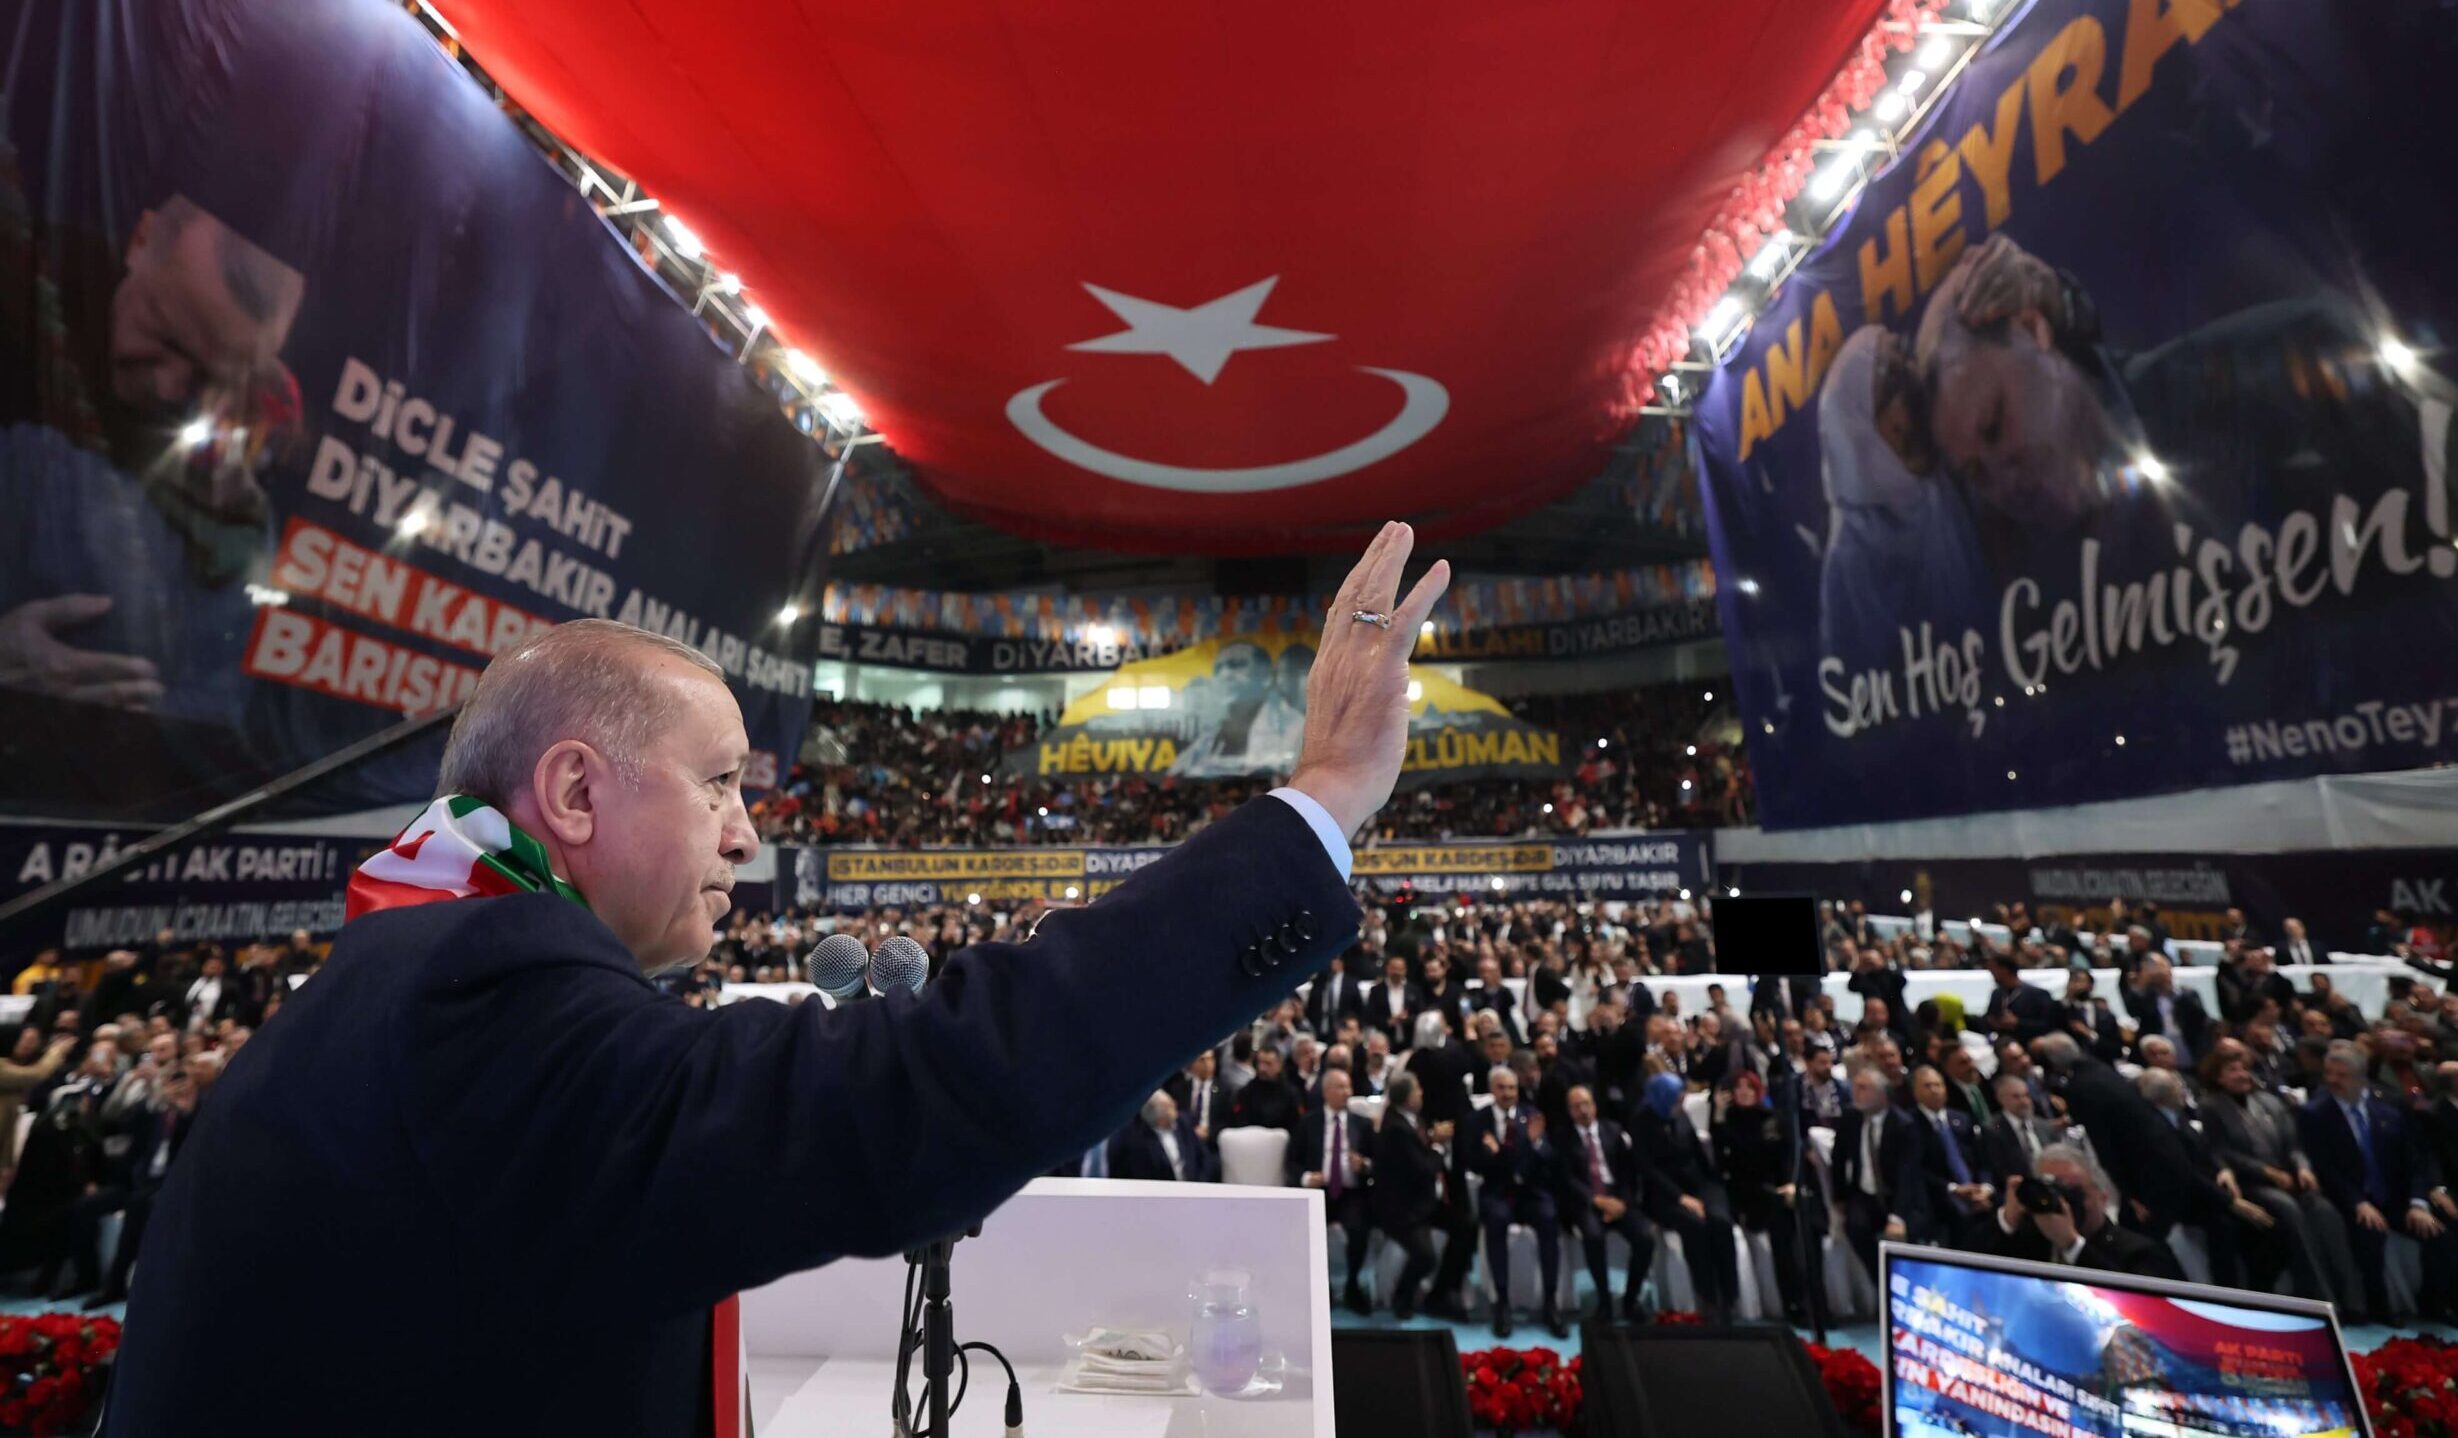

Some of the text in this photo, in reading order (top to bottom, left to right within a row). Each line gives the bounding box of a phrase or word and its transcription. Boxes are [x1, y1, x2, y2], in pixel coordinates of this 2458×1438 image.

[1738, 0, 2243, 463] ANA HÊYRA
[333, 357, 633, 560] DİCLE ŞAHİT
[280, 527, 402, 624] SEN
[307, 436, 617, 620] DİYARBAKIR
[858, 630, 969, 669] ZAFER
[1819, 656, 1894, 738] Sen
[1900, 621, 1985, 739] Hoş
[181, 845, 234, 882] AK
[2392, 878, 2452, 913] AK
